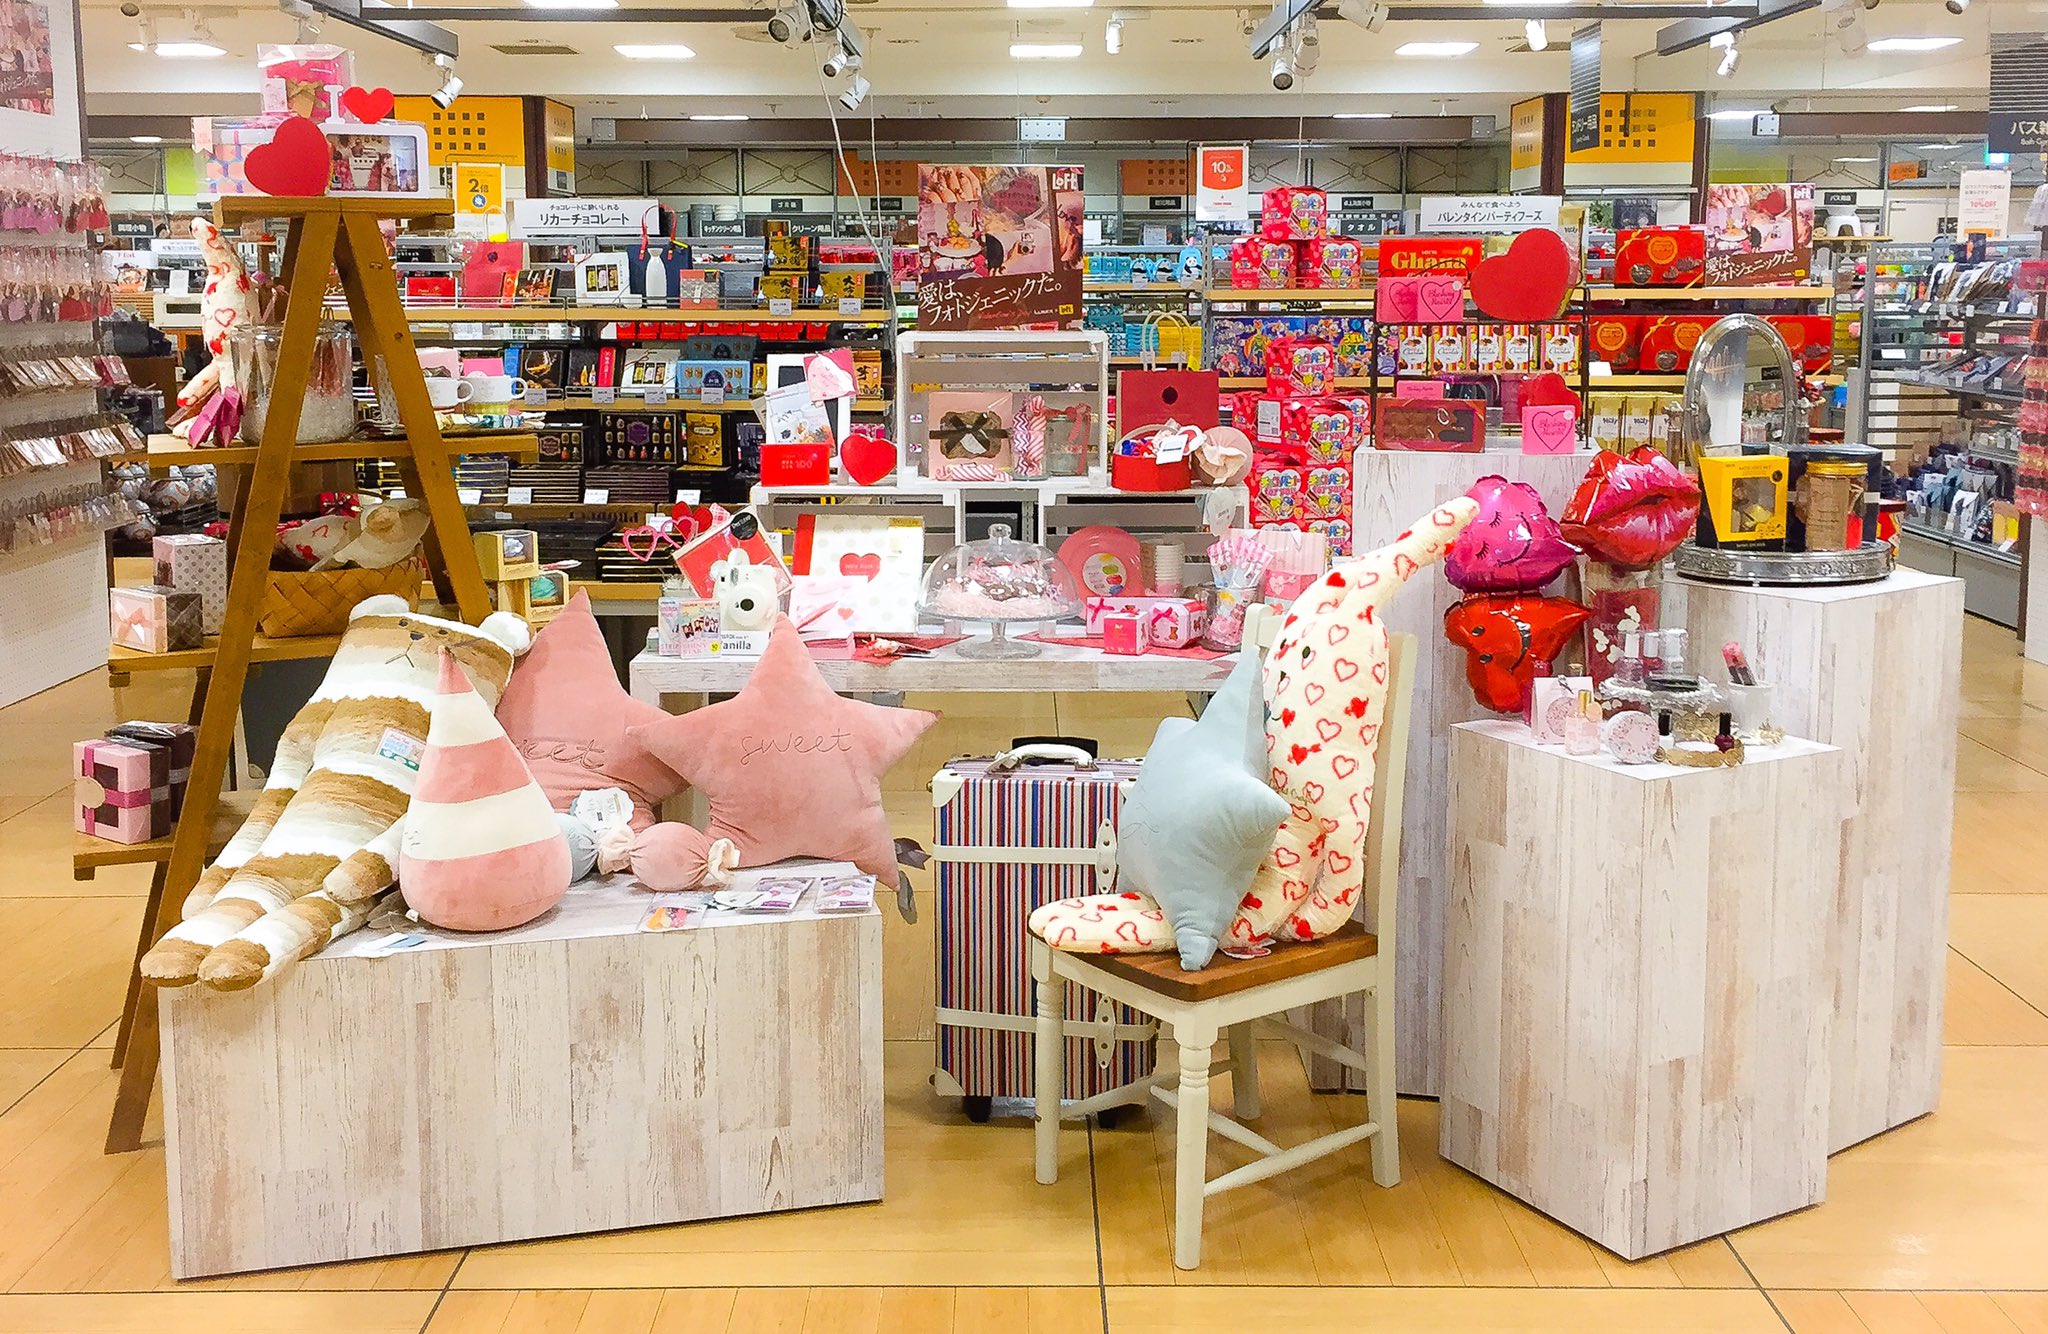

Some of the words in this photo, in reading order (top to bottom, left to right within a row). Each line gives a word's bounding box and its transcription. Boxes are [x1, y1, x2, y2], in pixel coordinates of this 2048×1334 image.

[549, 203, 620, 211] チョコレートに酔いしれる
[1460, 201, 1522, 209] みんなで食べよう
[539, 212, 630, 226] リカーチョコレート
[1391, 250, 1467, 270] Ghana
[917, 279, 964, 310] 愛は、
[926, 270, 1062, 327] フォトジェニックだ。
[720, 640, 752, 650] anilla
[739, 727, 854, 766] sweet
